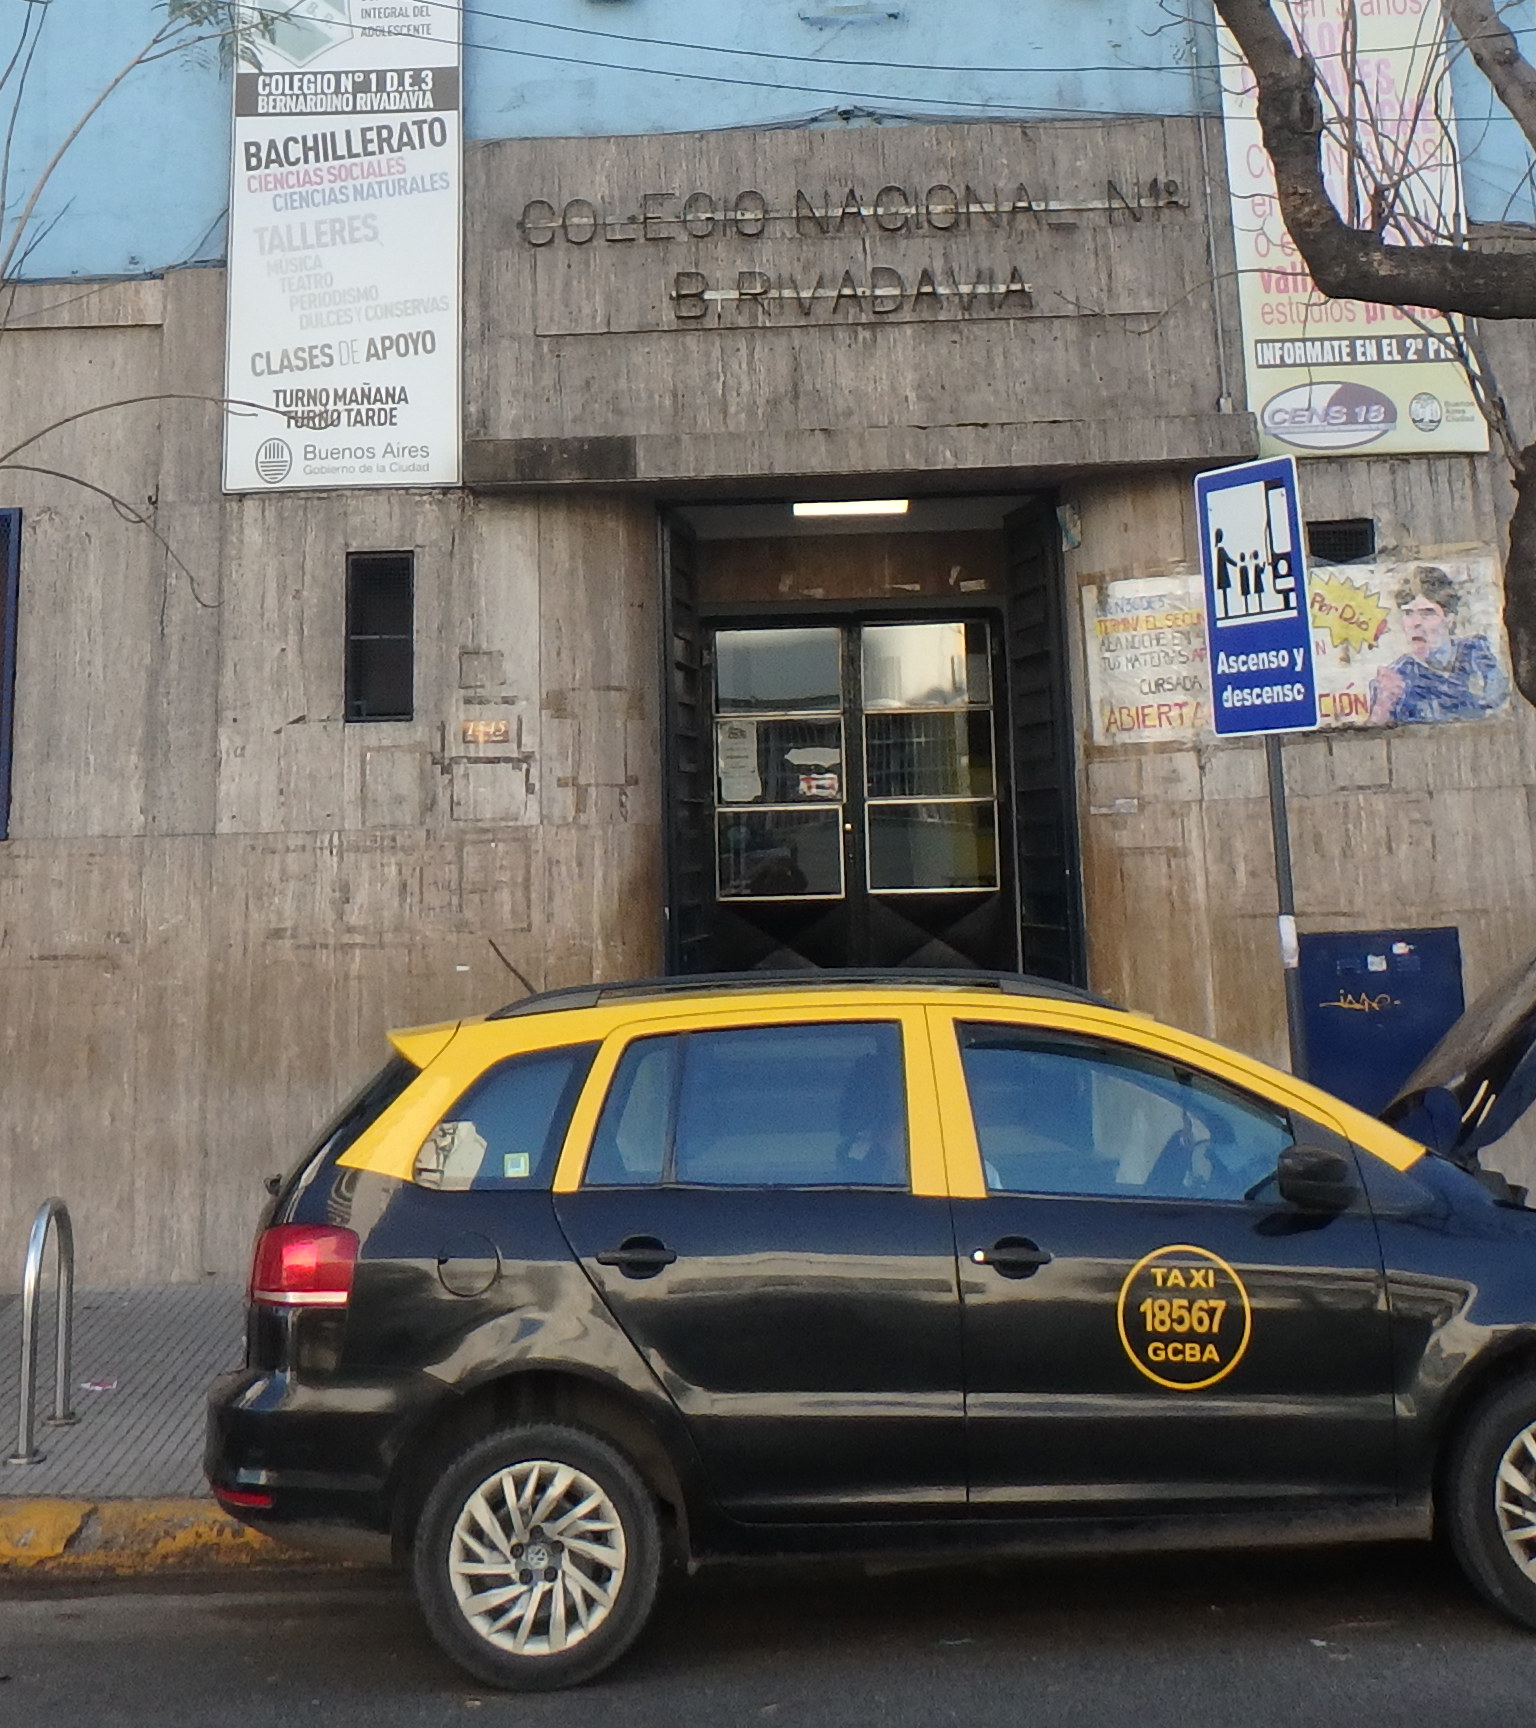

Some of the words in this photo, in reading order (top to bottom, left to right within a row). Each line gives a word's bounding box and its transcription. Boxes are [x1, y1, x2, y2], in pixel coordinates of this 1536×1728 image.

[360, 7, 411, 19] INTEGRAL
[413, 6, 432, 18] DEL
[360, 24, 432, 38] ADOLESCENTE
[257, 74, 335, 95] COLEGIO
[369, 72, 378, 92] 1
[257, 92, 354, 113] BERNARDINO
[356, 90, 434, 111] RIVADAVIA
[243, 116, 447, 172] BACHILLERATO
[247, 164, 324, 194] CIENCIAS
[327, 156, 407, 184] SOCIALES
[272, 183, 350, 212] CIENCIAS
[353, 171, 450, 202] NATURALES
[522, 189, 766, 248] COLEGIO
[796, 180, 1079, 235] NACIONAL
[253, 213, 380, 256] TALLERES
[279, 272, 334, 294] TEATRO
[737, 265, 1034, 317] RIVADAVIA
[289, 285, 379, 312] PERIODISMO
[299, 305, 353, 330] DULCES
[354, 305, 363, 323] Y
[365, 295, 450, 322] CONSERVAS
[251, 343, 335, 377] CLASES
[338, 338, 360, 366] DE
[365, 329, 437, 362] APOYO
[1256, 339, 1352, 365] INFORMATE
[1356, 339, 1377, 362] EN
[1382, 338, 1401, 360] EL
[273, 388, 331, 408] TURNO
[333, 383, 409, 407] MAÑANA
[286, 408, 341, 429] TURNO
[345, 407, 398, 428] TARDE
[1268, 405, 1347, 425] CENS
[1355, 404, 1385, 423] 18
[303, 444, 376, 461] Buenos
[382, 441, 430, 459] Aires
[303, 464, 355, 475] Gobierno
[358, 463, 373, 474] de
[376, 463, 386, 473] la
[389, 461, 430, 473] Ciudad
[1216, 649, 1290, 675] Ascenso
[1293, 647, 1305, 672] y
[1106, 701, 1208, 733] ABIERTA
[1150, 1267, 1215, 1289] TAXI
[1139, 1297, 1227, 1334] 18567
[1147, 1341, 1221, 1363] GCBA
